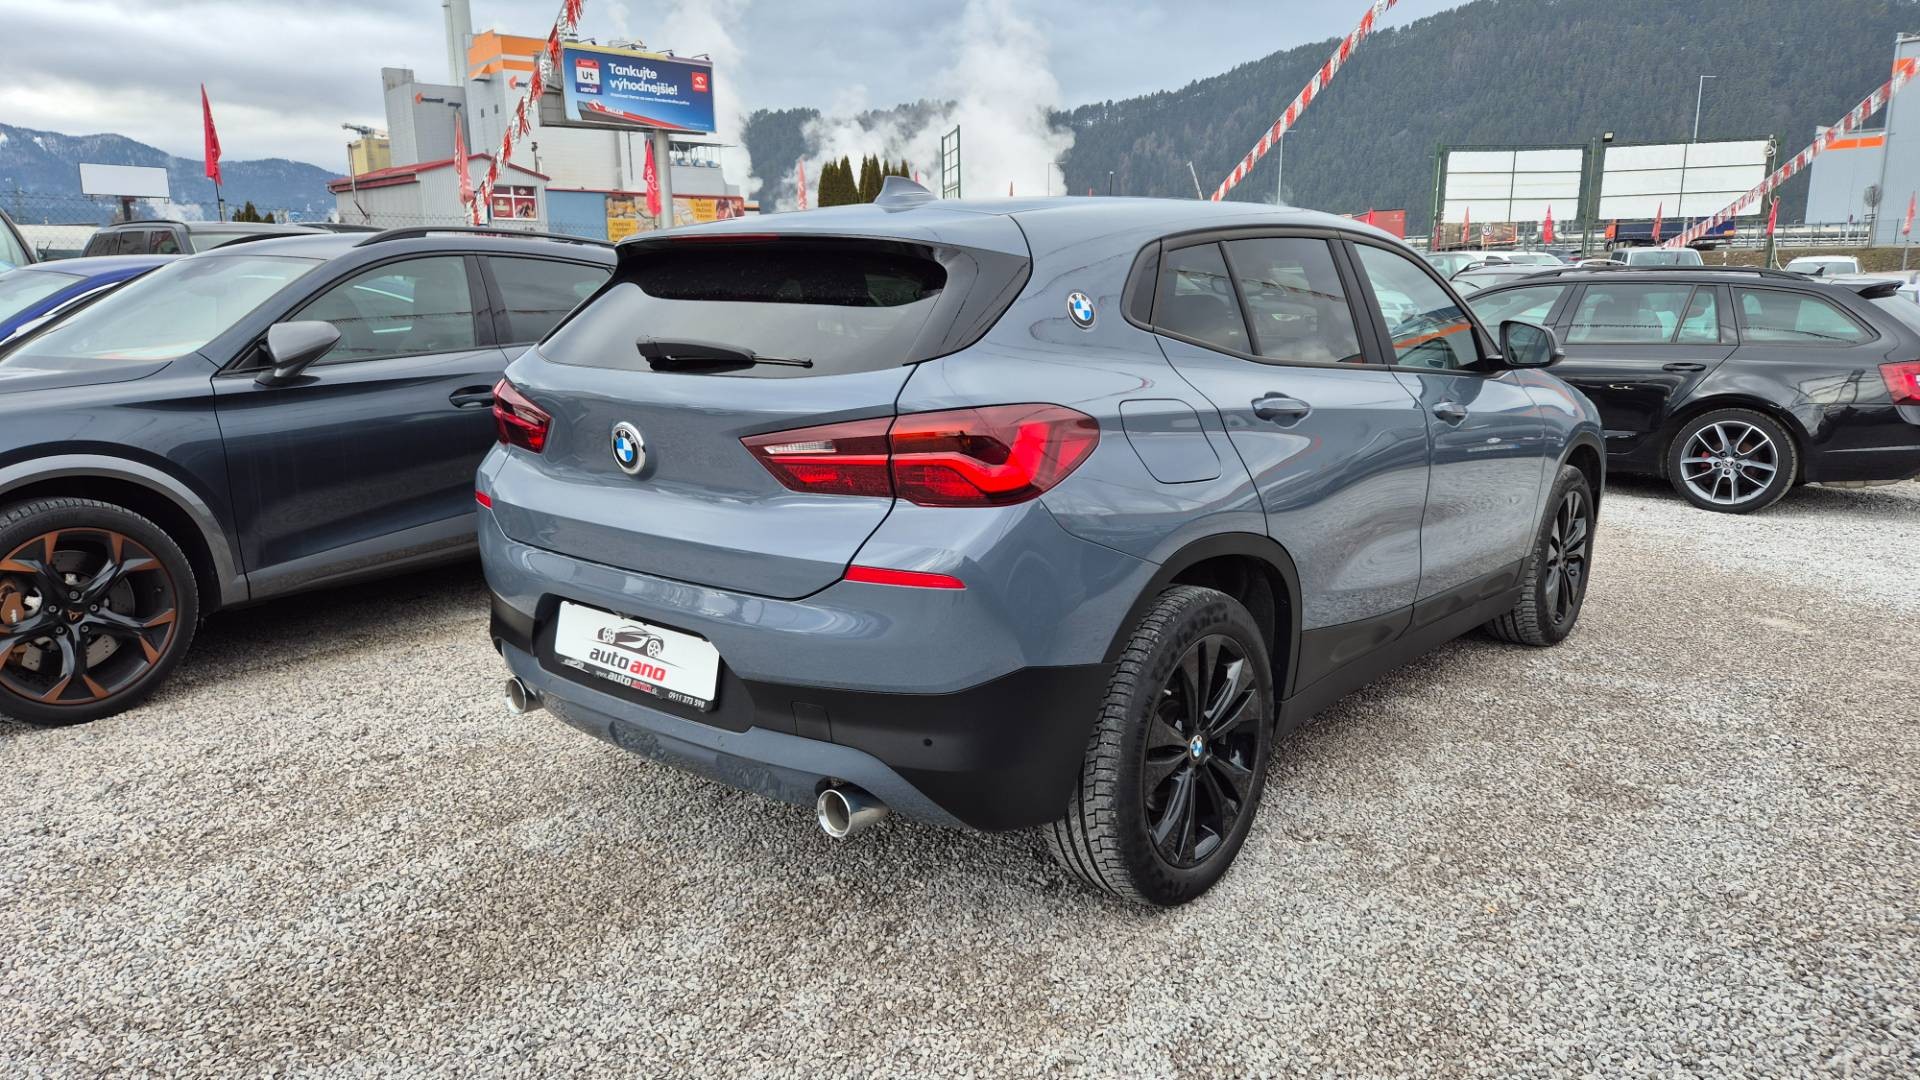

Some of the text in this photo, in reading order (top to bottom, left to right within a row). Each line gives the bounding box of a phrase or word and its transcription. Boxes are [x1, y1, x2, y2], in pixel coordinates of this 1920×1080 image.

[582, 71, 594, 80] Ut
[608, 63, 657, 81] Tankujte
[609, 77, 678, 95] výhodnejšie!
[589, 647, 666, 681] auto ano
[668, 691, 682, 702] 0911
